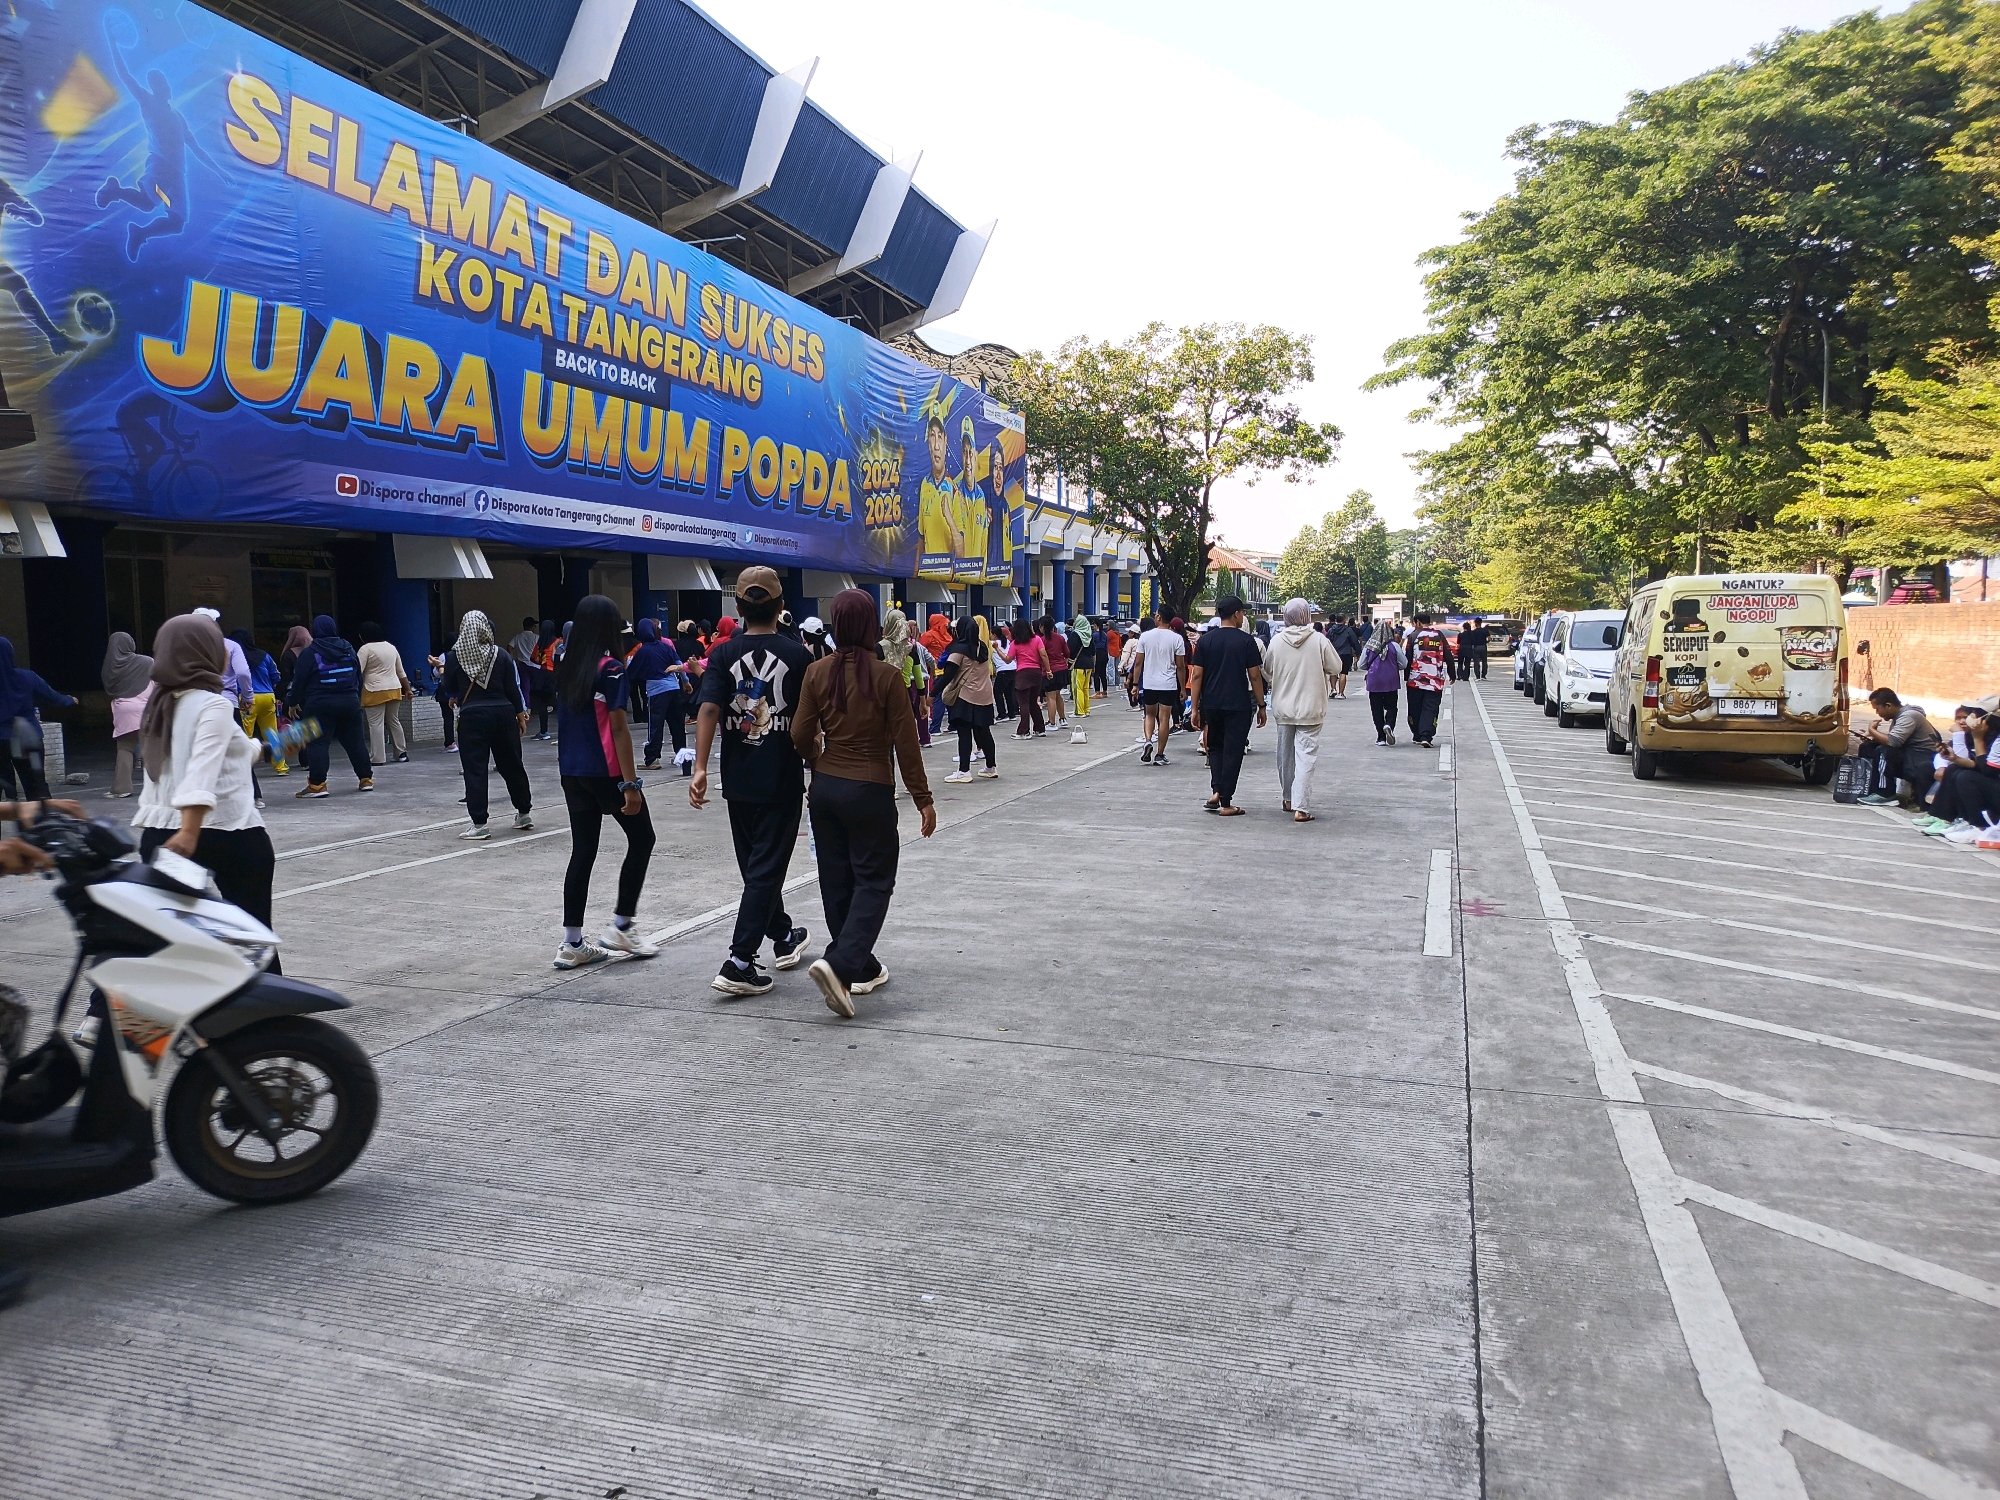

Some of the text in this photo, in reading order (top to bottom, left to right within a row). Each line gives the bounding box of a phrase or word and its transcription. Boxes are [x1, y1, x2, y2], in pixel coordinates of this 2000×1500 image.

[225, 71, 826, 382] SELAMAT DAN SUKSES
[417, 240, 762, 403] KOTA TANGERANG
[555, 348, 657, 394] BACK TO BACK
[140, 278, 853, 519] JUARA UMUM POPDA
[862, 459, 900, 491] 2024
[361, 480, 466, 508] Dispora channel
[491, 497, 636, 527] Dispora Kota Tangerang Channel
[864, 494, 902, 526] 2026
[654, 517, 737, 542] disporakotatangerang
[754, 533, 799, 551] DisporaKotaTng
[1721, 579, 1784, 590] NGANTUK?
[1708, 595, 1797, 609] JANGAN LUPA
[1728, 609, 1775, 622] NGOPI!
[1663, 636, 1709, 652] SERUPUT
[1785, 637, 1834, 653] NAGA
[1720, 700, 1776, 709] D 8867 FH
